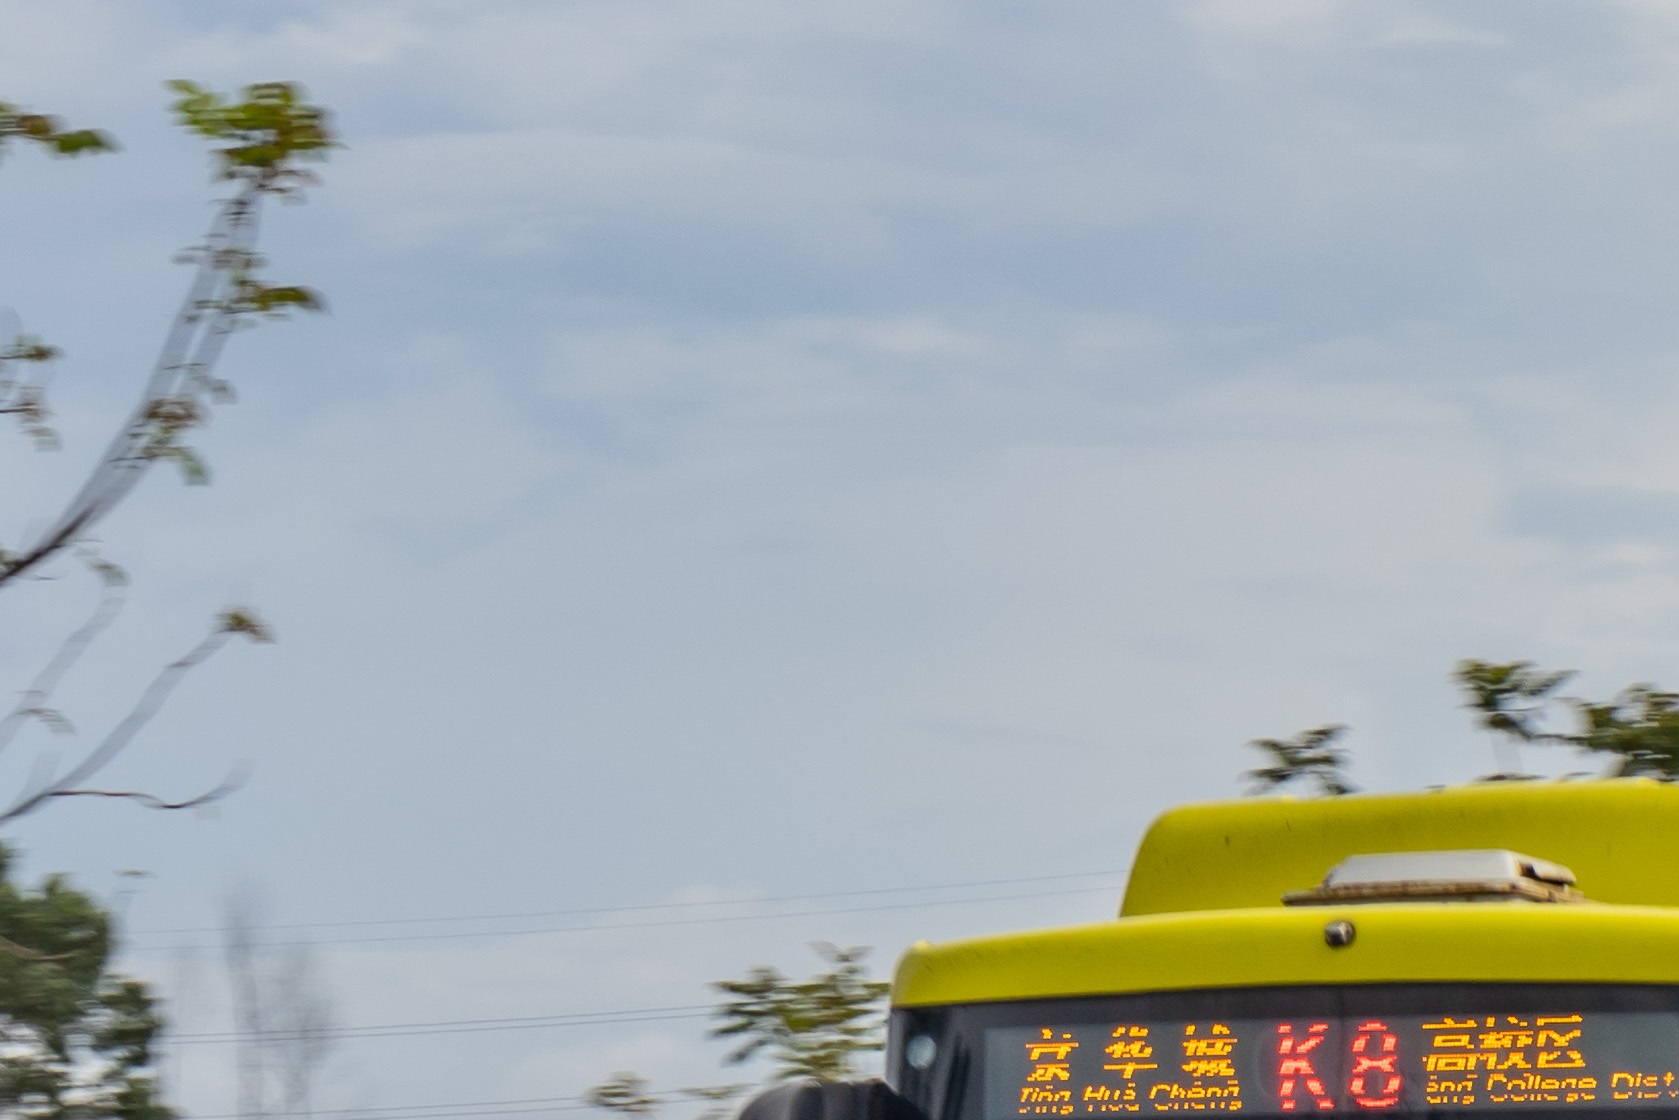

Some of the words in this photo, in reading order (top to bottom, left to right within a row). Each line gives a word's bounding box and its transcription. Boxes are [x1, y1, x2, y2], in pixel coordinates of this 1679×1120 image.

[1276, 1021, 1401, 1111] K8
[1422, 1014, 1586, 1072] 高校区
